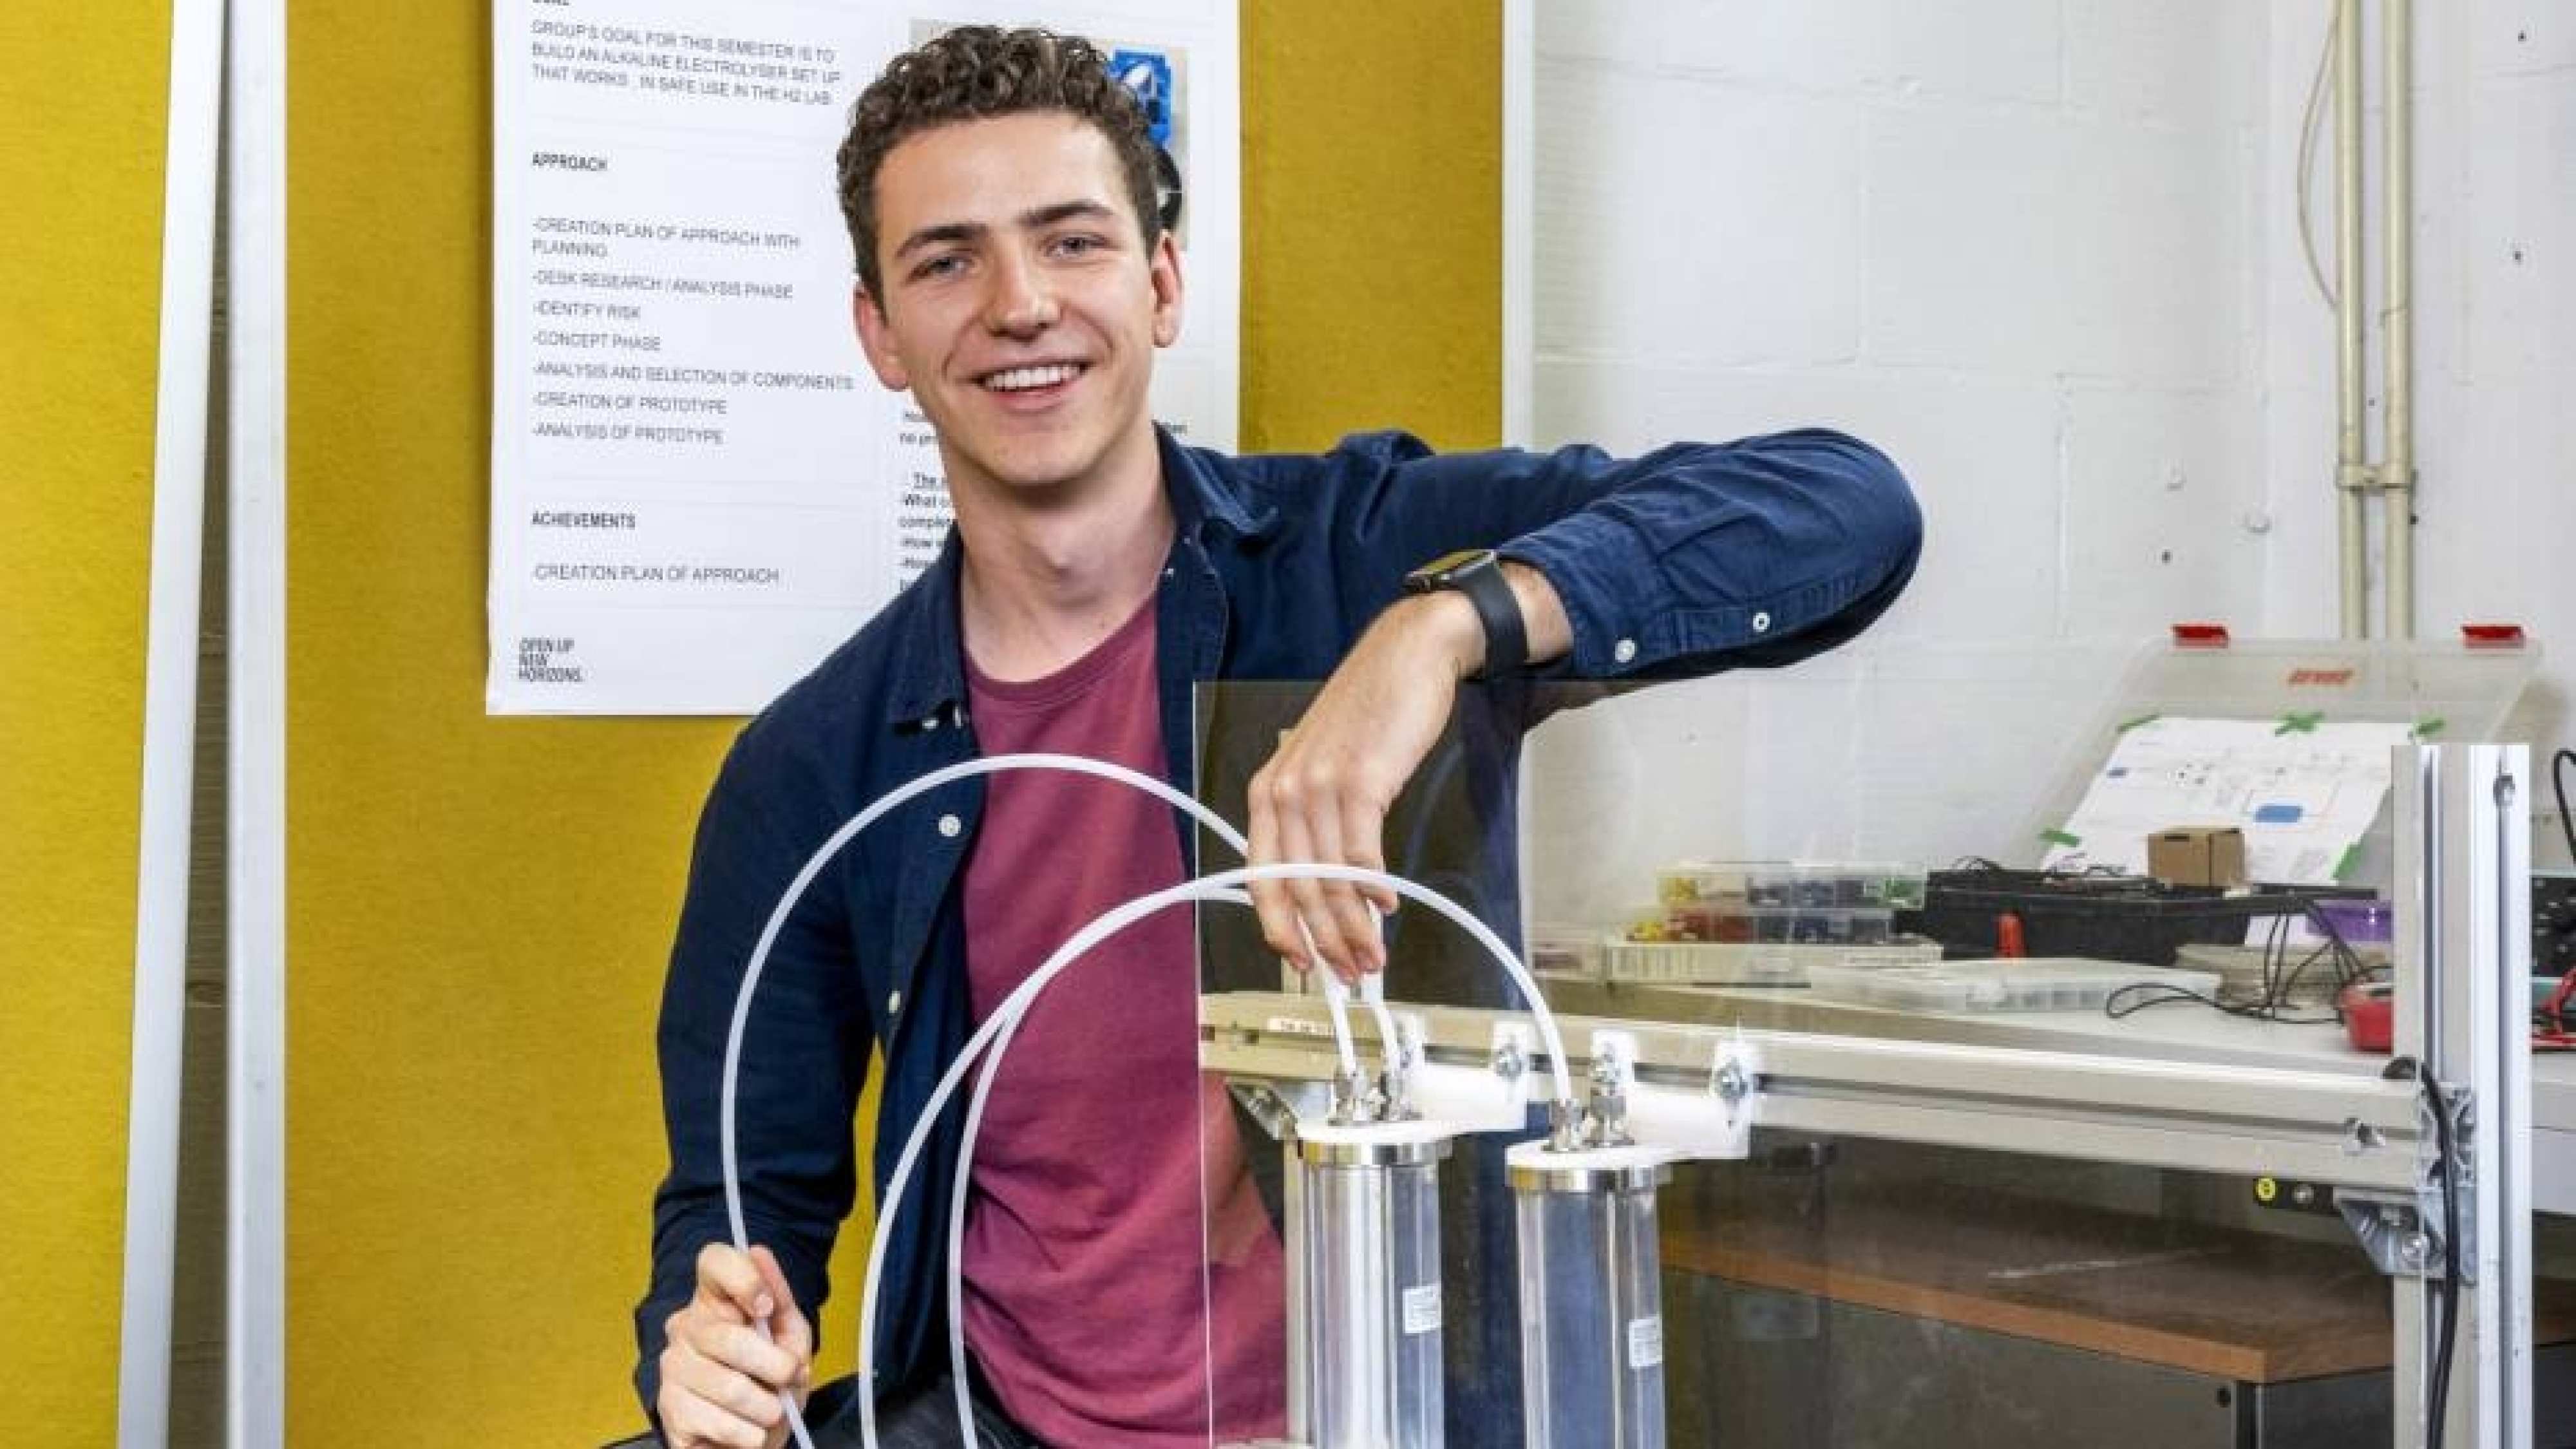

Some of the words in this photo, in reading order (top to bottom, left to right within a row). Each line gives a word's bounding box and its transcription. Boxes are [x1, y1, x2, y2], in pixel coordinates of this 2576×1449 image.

[603, 27, 641, 46] GOAL
[646, 31, 676, 48] FOR
[682, 35, 712, 52] THIS
[718, 38, 793, 59] SEMESTER
[799, 46, 813, 61] IS
[817, 48, 835, 64] TO
[532, 43, 575, 61] BUILD
[578, 47, 599, 63] AN
[602, 49, 670, 70] ALKALINE
[676, 55, 788, 79] ELECTROLYSER
[792, 66, 819, 83] SET
[823, 70, 840, 84] UP
[533, 64, 569, 82] THAT
[640, 75, 655, 89] IN
[659, 77, 696, 95] SAFE
[701, 82, 729, 97] USE
[735, 84, 749, 97] IN
[752, 85, 779, 101] THE
[532, 153, 608, 172] APPROACH
[616, 222, 652, 239] PLAN
[657, 225, 677, 240] OF
[681, 226, 760, 247] APPROACH
[765, 232, 801, 249] WITH
[582, 272, 662, 292] RESEARCH
[673, 278, 741, 298] ANALYSIS
[746, 281, 793, 299] PHASE
[607, 304, 640, 320] RISK
[612, 333, 661, 352] PHASE
[612, 366, 641, 382] AND
[646, 367, 727, 386] SELECTION
[730, 371, 749, 386] OF
[753, 372, 855, 391] COMPONENTS
[616, 395, 636, 410] OF
[640, 396, 728, 415] PROTOTYPE
[612, 426, 632, 442] OF
[636, 426, 724, 445] PROTOTYPE
[532, 511, 636, 529] ACHIEVEMENTS
[621, 565, 663, 582] PLAN
[668, 565, 688, 582] OF
[692, 567, 779, 583] APPROACH
[519, 638, 553, 653] OPEN
[557, 638, 575, 653] UP
[519, 654, 549, 667] NEW
